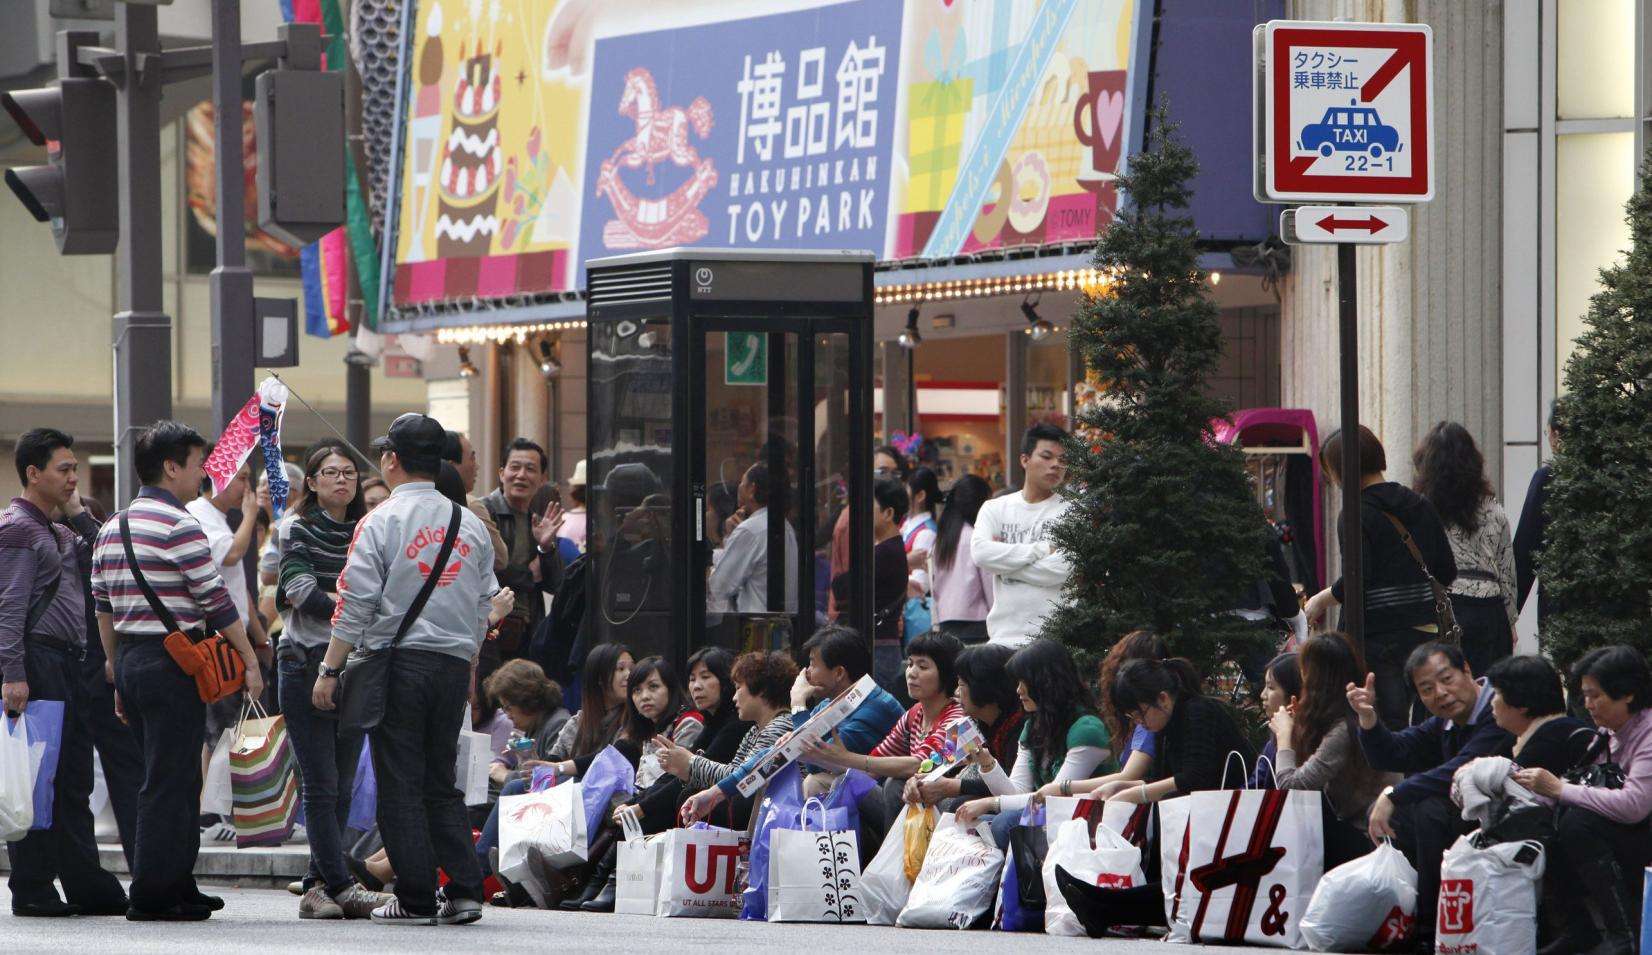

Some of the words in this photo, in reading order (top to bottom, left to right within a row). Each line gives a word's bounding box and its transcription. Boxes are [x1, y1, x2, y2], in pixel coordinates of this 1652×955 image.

[1294, 51, 1358, 69] タクシー
[1294, 71, 1359, 89] 乗車禁止
[737, 35, 886, 164] 博品館
[1333, 129, 1368, 143] TAXI
[1345, 155, 1393, 172] 22-1
[729, 156, 877, 197] HAKUHINKAN
[727, 199, 788, 244] TOY
[797, 188, 875, 237] PARK
[685, 844, 740, 894] UT
[693, 899, 705, 907] ALL
